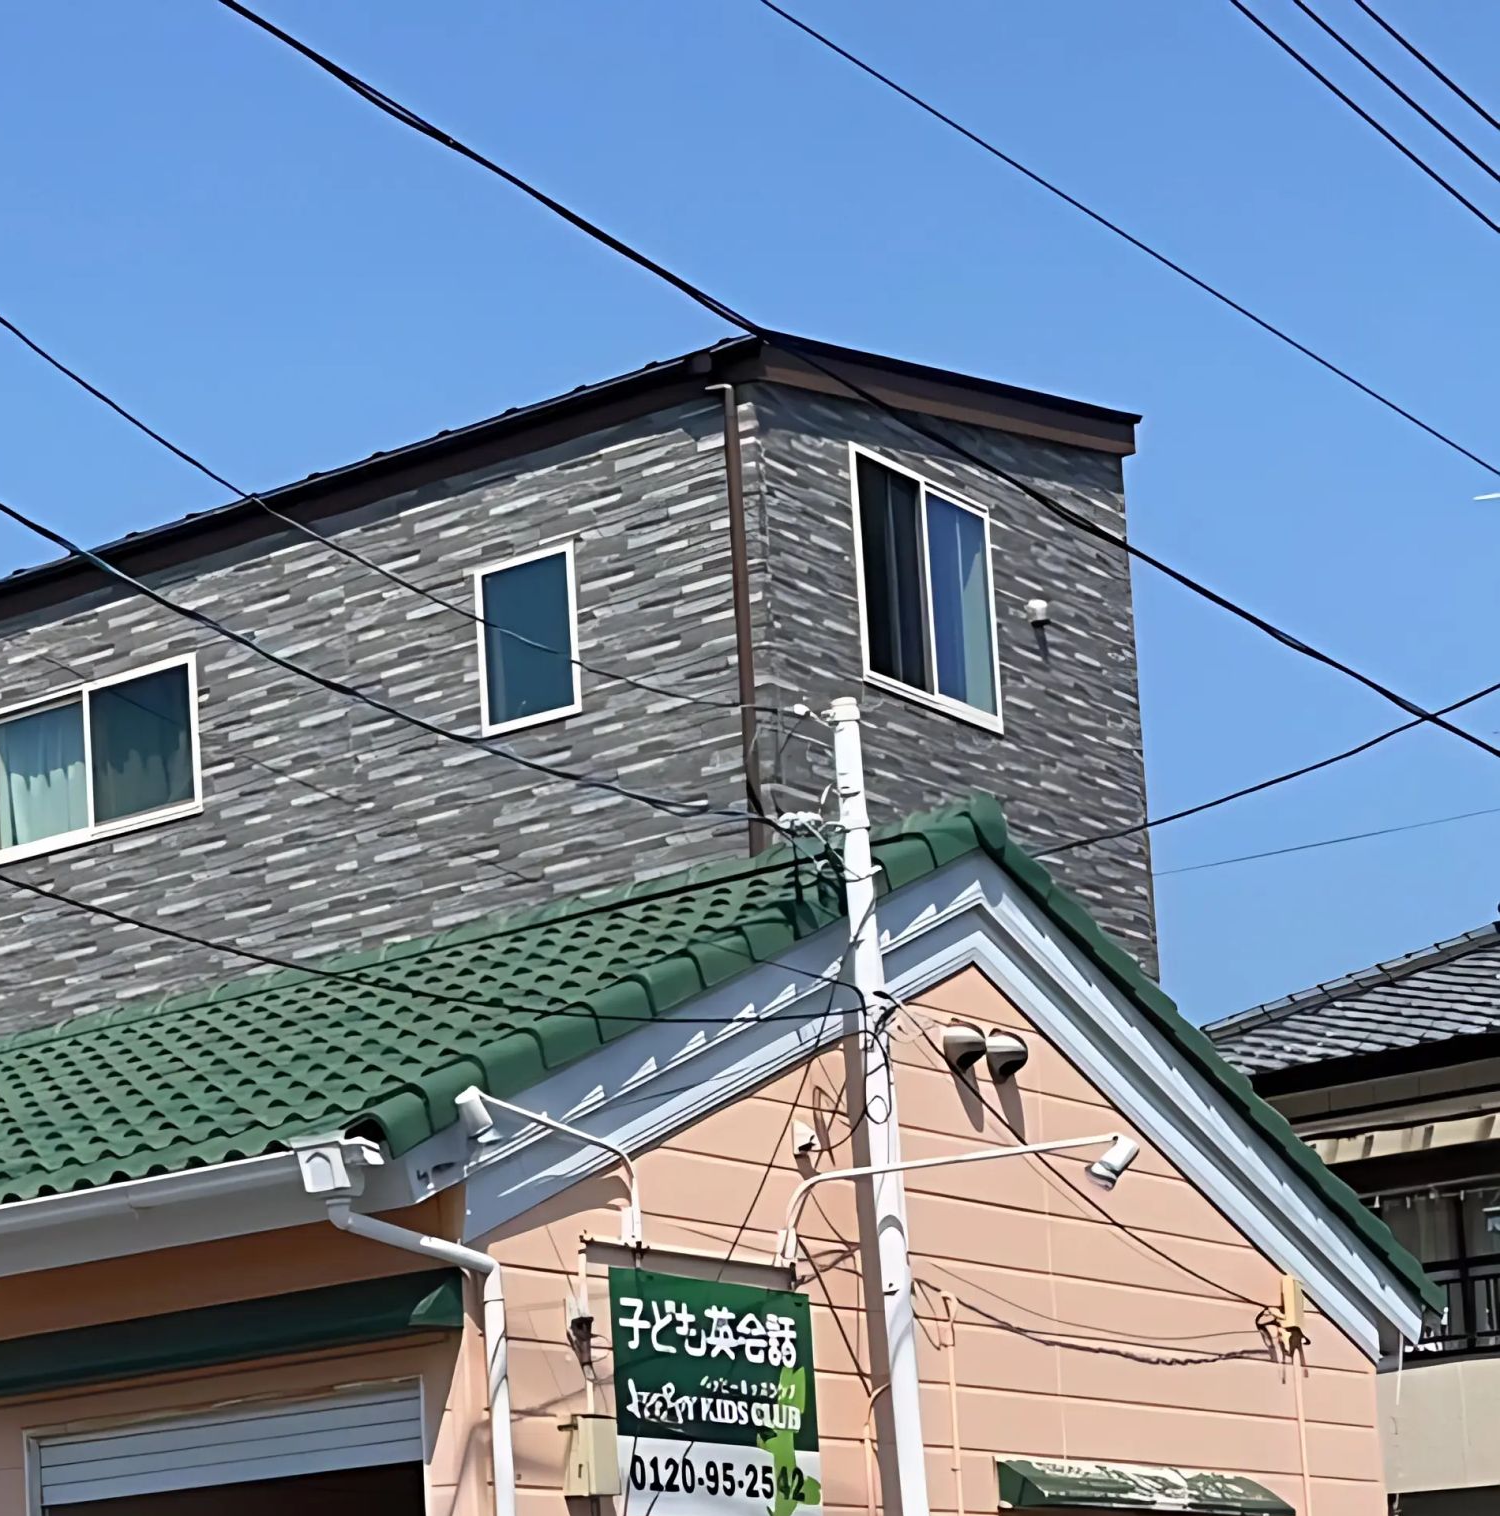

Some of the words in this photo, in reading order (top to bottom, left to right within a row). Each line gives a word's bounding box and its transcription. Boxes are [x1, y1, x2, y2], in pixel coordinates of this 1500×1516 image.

[618, 1297, 797, 1368] 子ども英会話
[700, 1396, 749, 1425] KIDS
[751, 1402, 802, 1432] CLUB
